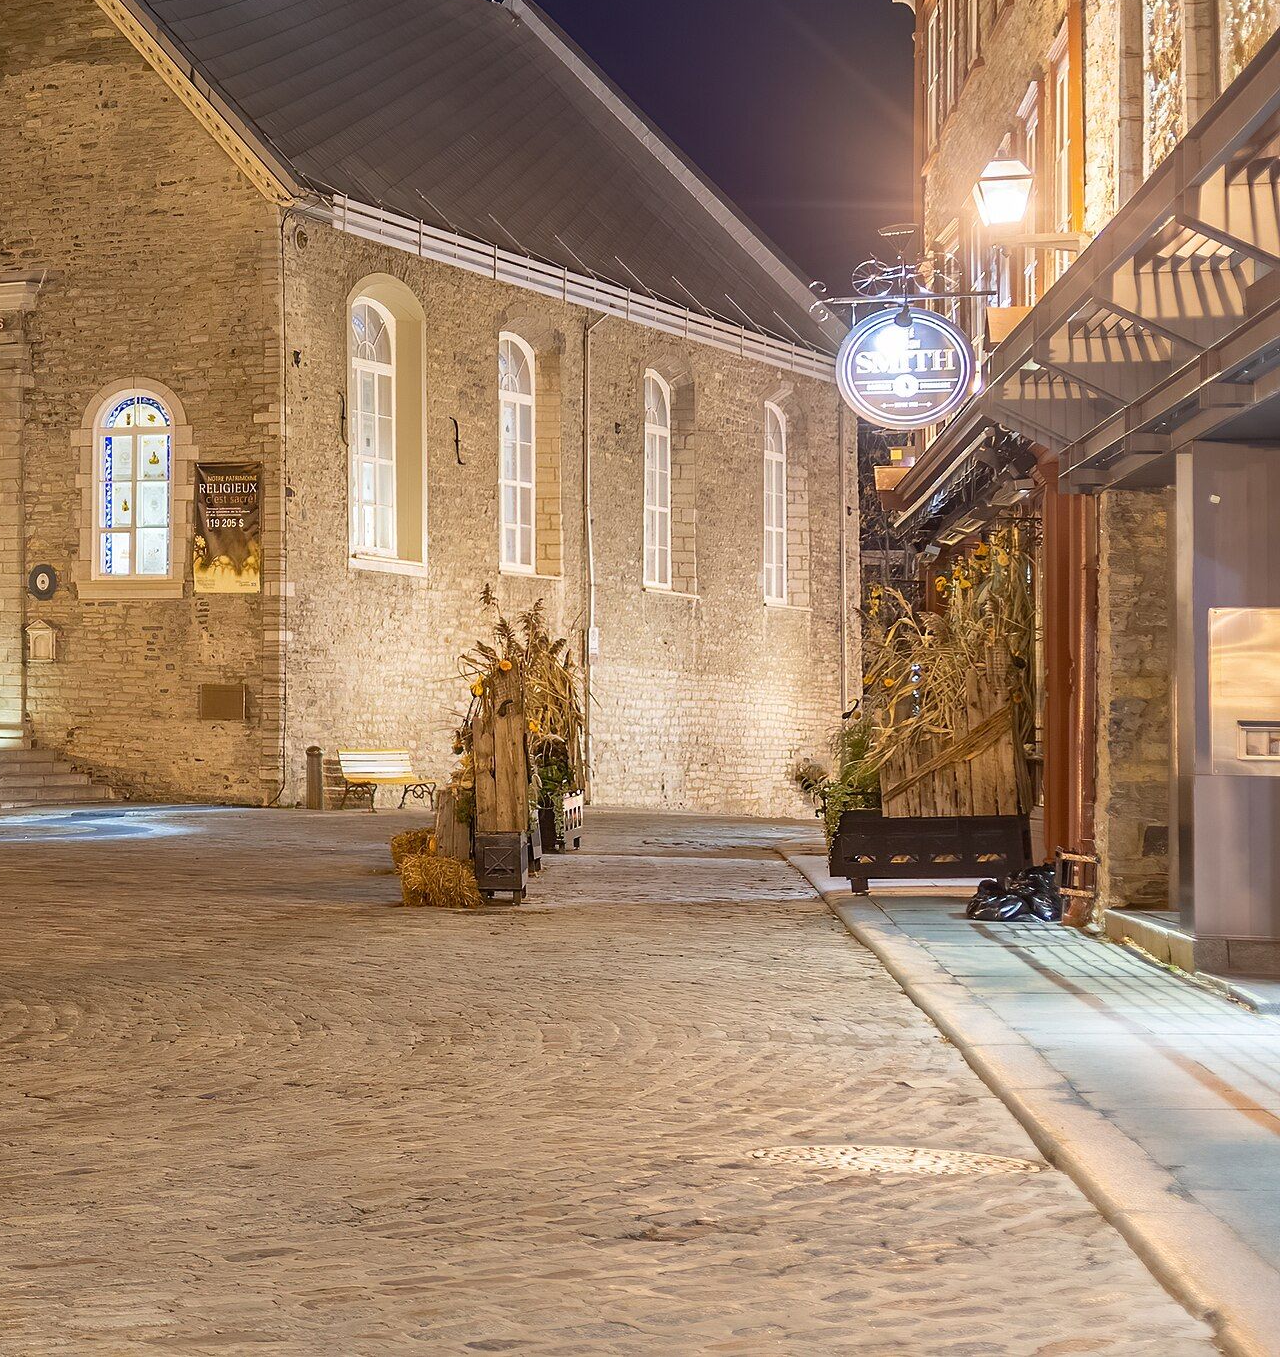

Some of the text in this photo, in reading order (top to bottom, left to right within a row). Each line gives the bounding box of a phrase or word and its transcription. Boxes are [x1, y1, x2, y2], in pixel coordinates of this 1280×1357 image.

[855, 348, 956, 374] SMITH
[199, 483, 257, 494] RELIGIEUX
[206, 518, 220, 528] 119
[221, 518, 237, 528] 205
